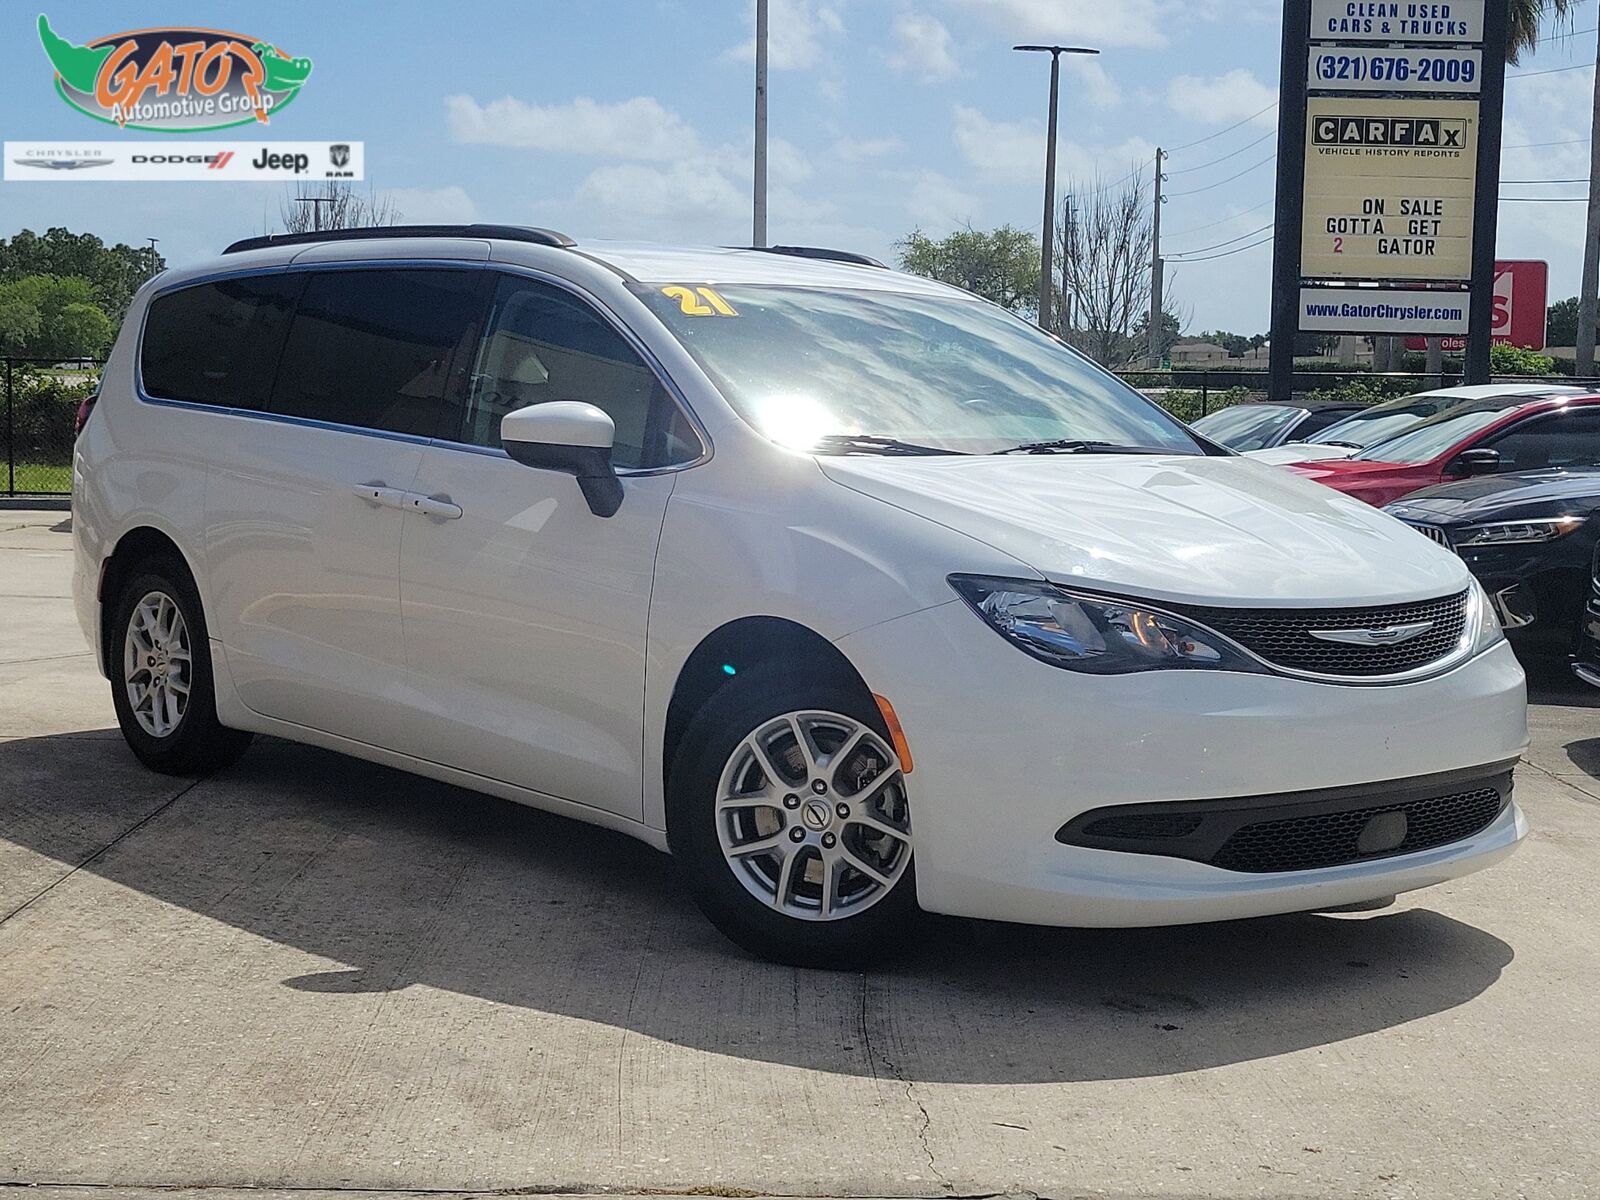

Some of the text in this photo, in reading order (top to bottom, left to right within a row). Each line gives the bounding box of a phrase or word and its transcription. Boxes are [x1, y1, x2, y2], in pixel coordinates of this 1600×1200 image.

[1346, 2, 1450, 19] CLEAN USED
[1328, 18, 1467, 35] CARS & TRUCKS
[1318, 120, 1461, 147] CARFAX
[1318, 148, 1460, 158] VEHICLE HISTORY REPORTS
[1363, 198, 1443, 215] ON SALE
[1326, 217, 1441, 235] GOTTA GET
[1333, 237, 1435, 255] 2 GATOR
[661, 285, 738, 317] 21
[1306, 303, 1462, 321] www.GatorChrysler.com
